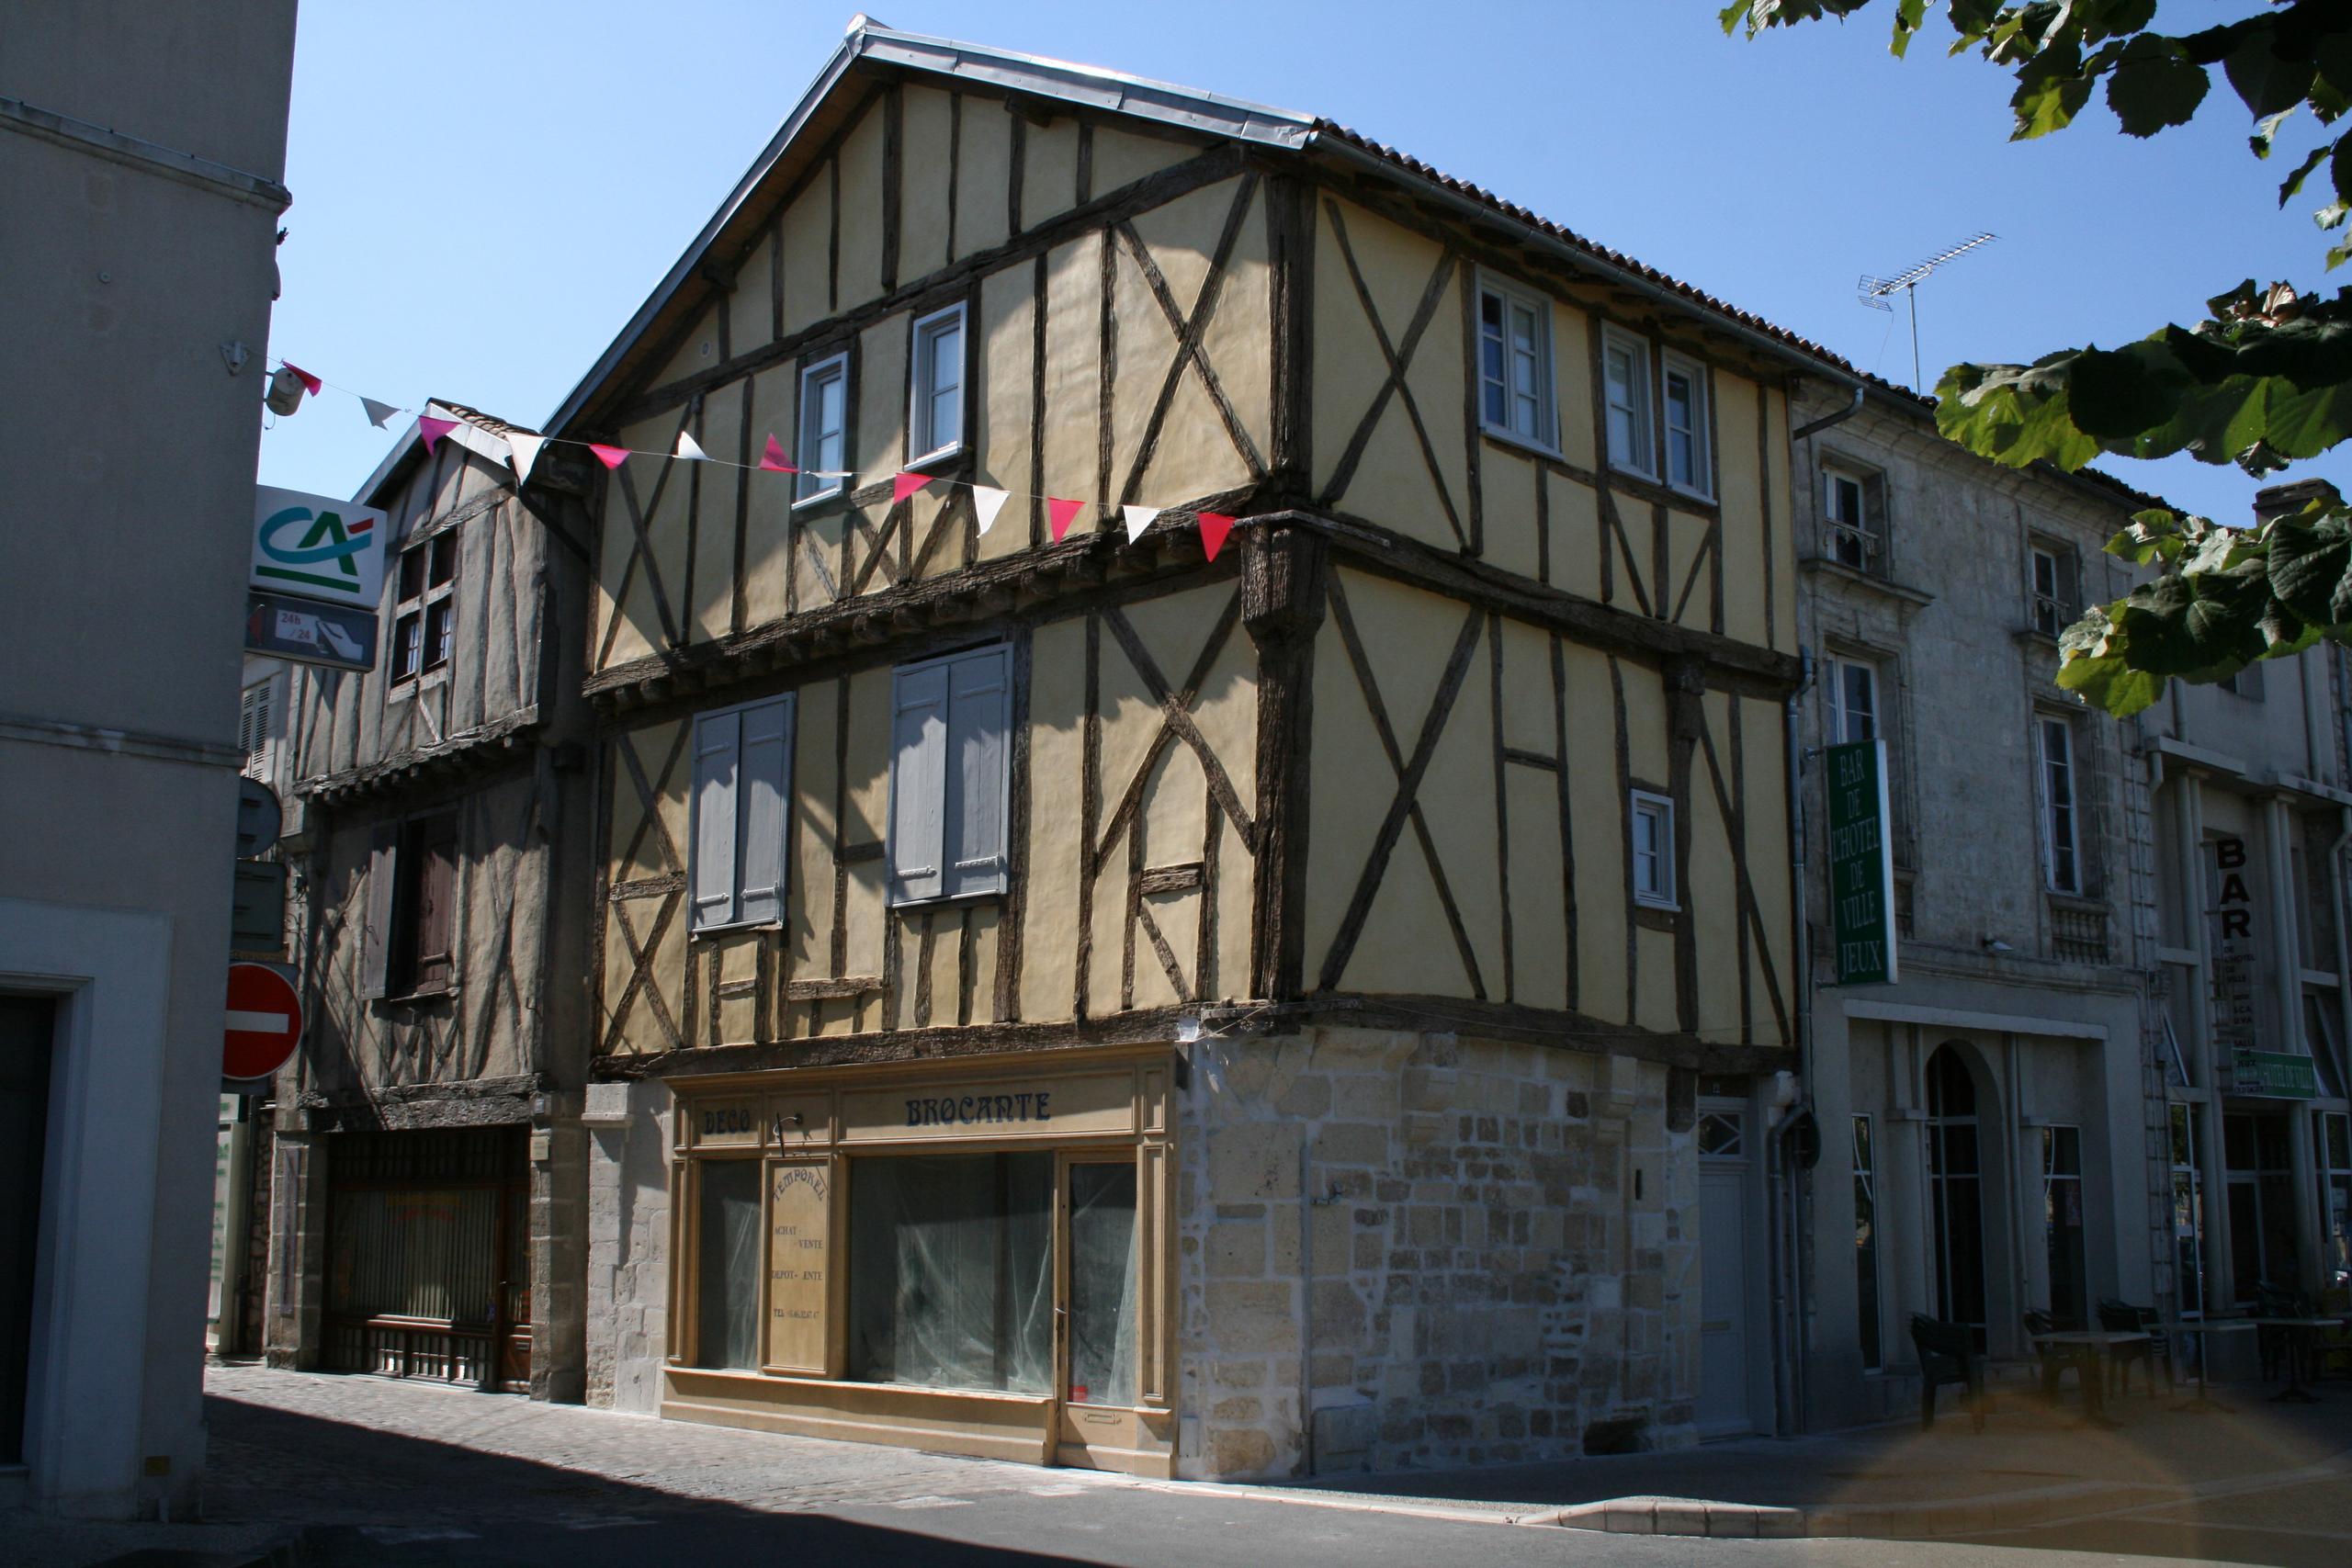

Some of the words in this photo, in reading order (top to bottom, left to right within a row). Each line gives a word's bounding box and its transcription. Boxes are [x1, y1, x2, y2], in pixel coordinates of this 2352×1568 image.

[280, 613, 301, 626] 24h
[1839, 749, 1865, 787] BAR
[1847, 787, 1862, 820] DE
[1832, 816, 1881, 863] L'HOTEL
[1849, 860, 1866, 892] DE
[2217, 838, 2251, 940] BAR
[1842, 890, 1877, 932] VILLE
[1841, 940, 1883, 980] JEUX
[906, 1093, 1050, 1126] BROCANTE
